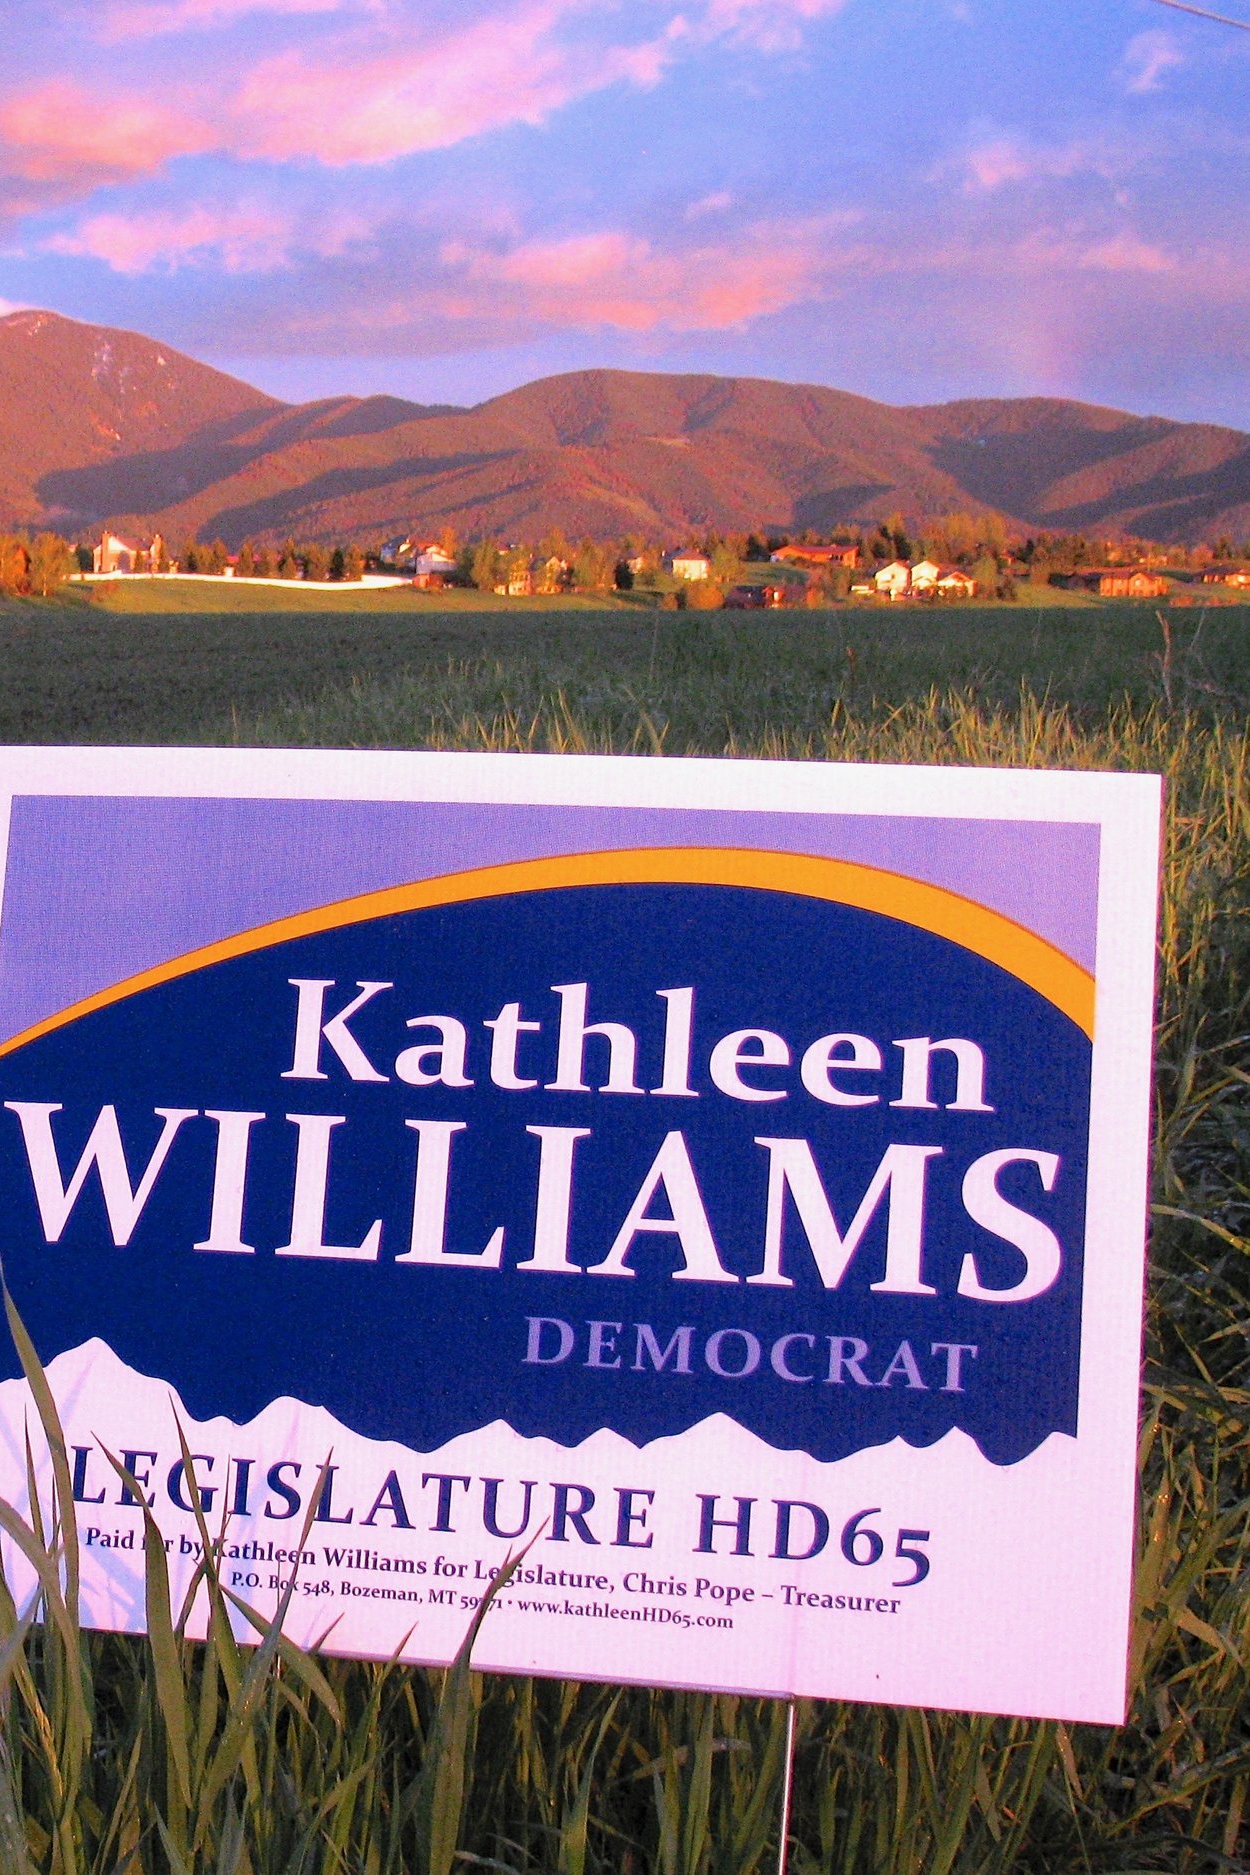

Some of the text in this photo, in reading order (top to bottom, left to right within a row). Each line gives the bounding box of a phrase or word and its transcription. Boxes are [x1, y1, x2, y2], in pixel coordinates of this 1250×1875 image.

[280, 979, 995, 1112] Kathleen
[4, 1101, 1063, 1302] WILLIAMS
[521, 1316, 978, 1393] DEMOCRAT
[71, 1445, 931, 1588] LEGISLATURE HD65
[86, 1527, 135, 1550] Paid
[179, 1534, 206, 1561] by
[323, 1547, 427, 1575] Williams
[433, 1556, 468, 1578] for
[623, 1572, 688, 1597] Chris
[694, 1578, 756, 1605] Pope
[781, 1585, 901, 1614] Treasurer
[231, 1572, 263, 1589] P.O.
[303, 1580, 335, 1596] 548,
[340, 1582, 424, 1604] Bozeman,
[428, 1589, 458, 1605] MT
[517, 1600, 734, 1629] www.kathleenHD65.com
